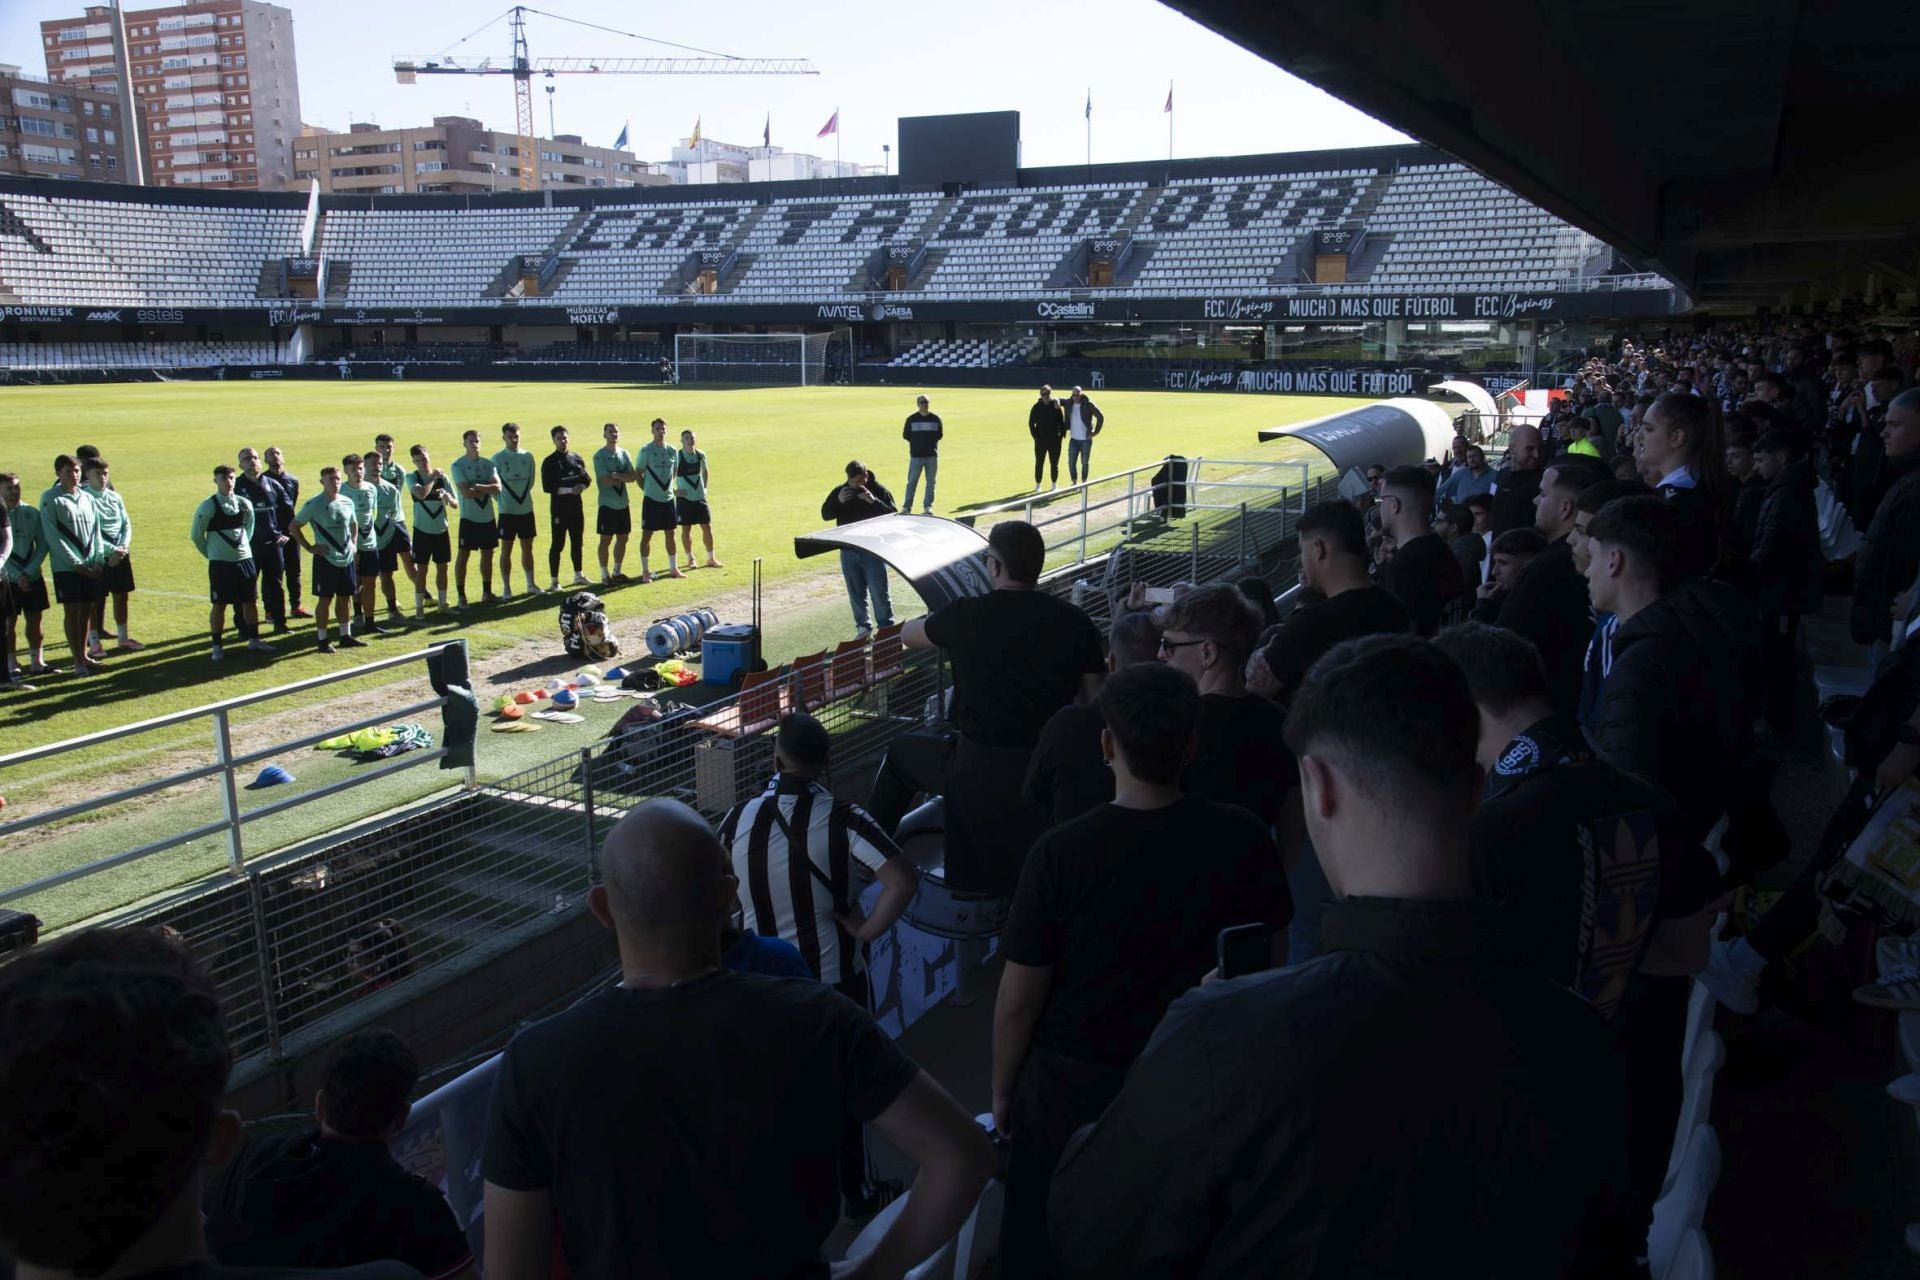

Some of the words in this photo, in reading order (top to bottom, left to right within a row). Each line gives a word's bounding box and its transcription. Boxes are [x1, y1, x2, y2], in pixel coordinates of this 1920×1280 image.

[4, 306, 74, 316] RONIWESK
[566, 306, 608, 315] MUDANZAS
[817, 305, 864, 318] AVATEL
[885, 307, 913, 316] CAESA
[1048, 302, 1095, 315] Castellini
[1204, 300, 1225, 318] FCC
[1289, 299, 1336, 317] MUCHO
[1373, 298, 1400, 316] QUE
[1404, 295, 1458, 316] FÚTBOL
[1475, 296, 1499, 316] FCC
[137, 309, 184, 321] estels
[570, 314, 605, 324] MOFLY
[1331, 373, 1357, 393] QUE
[1500, 741, 1531, 770] 1995
